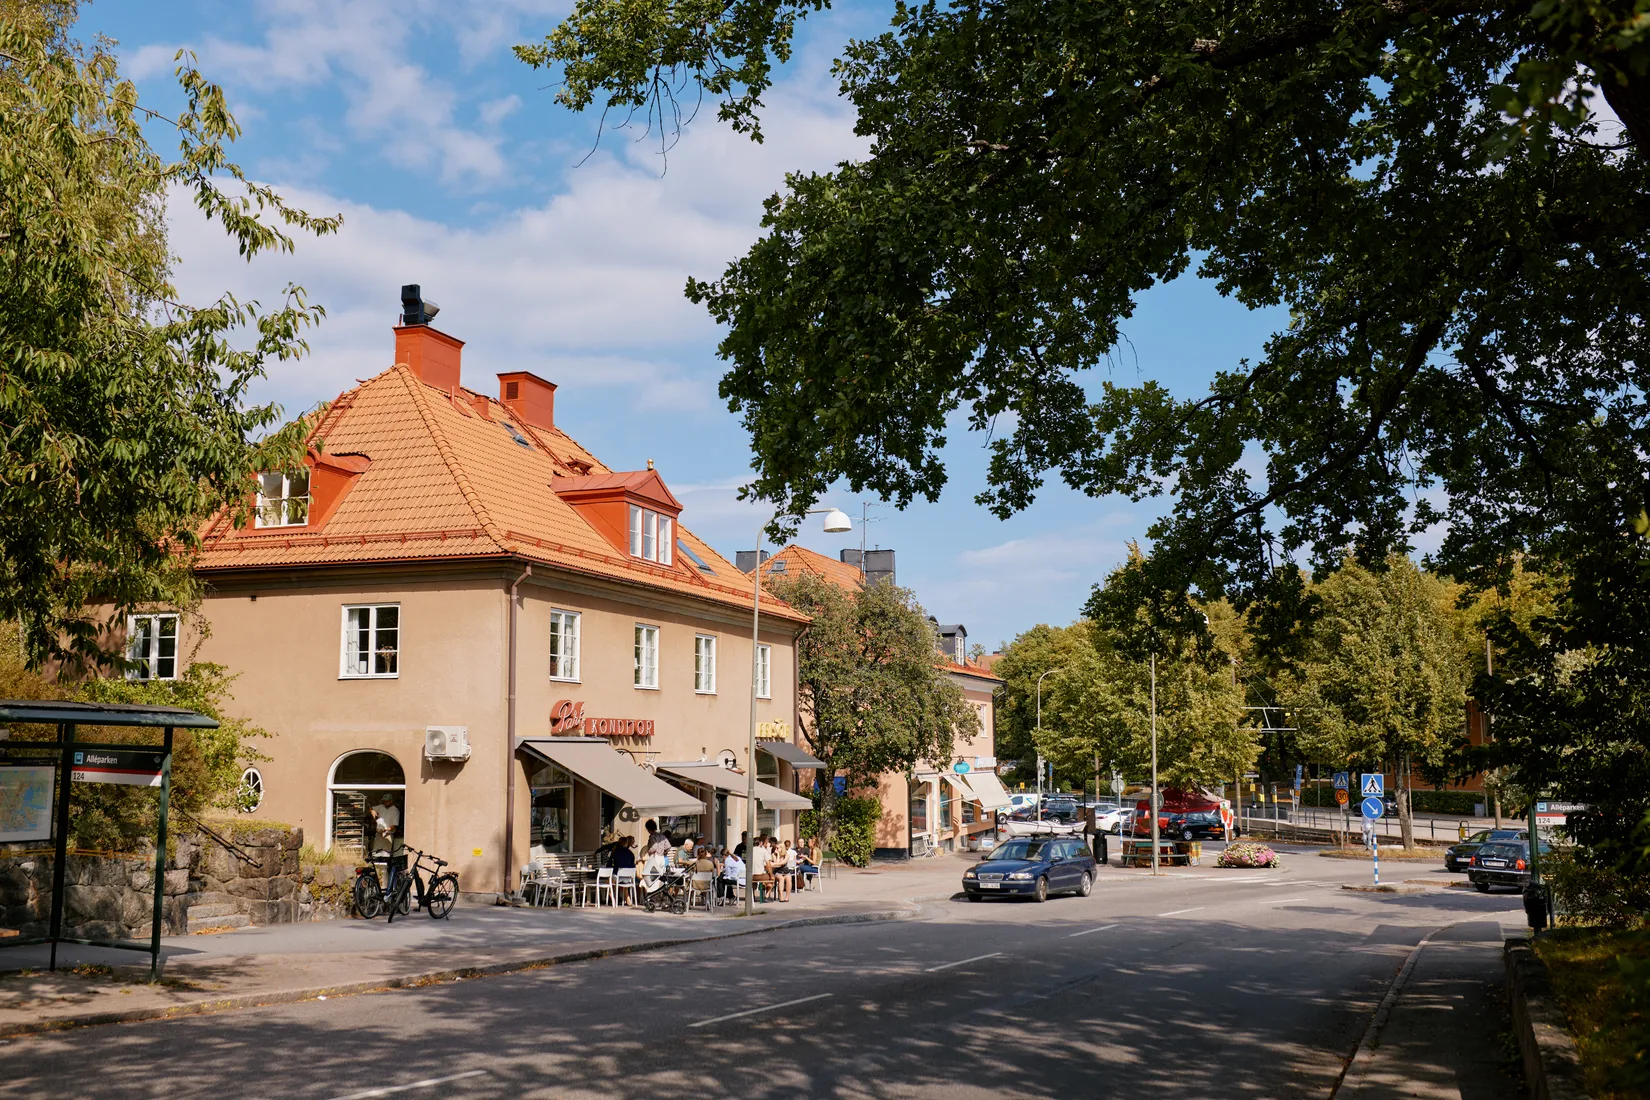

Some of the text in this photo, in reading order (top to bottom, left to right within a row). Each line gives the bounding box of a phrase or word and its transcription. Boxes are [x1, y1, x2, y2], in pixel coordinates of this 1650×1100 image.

[553, 700, 586, 734] Park
[86, 754, 118, 765] Alléparken
[73, 772, 85, 780] 124
[1338, 792, 1347, 801] 30
[1550, 803, 1585, 812] Alléparken
